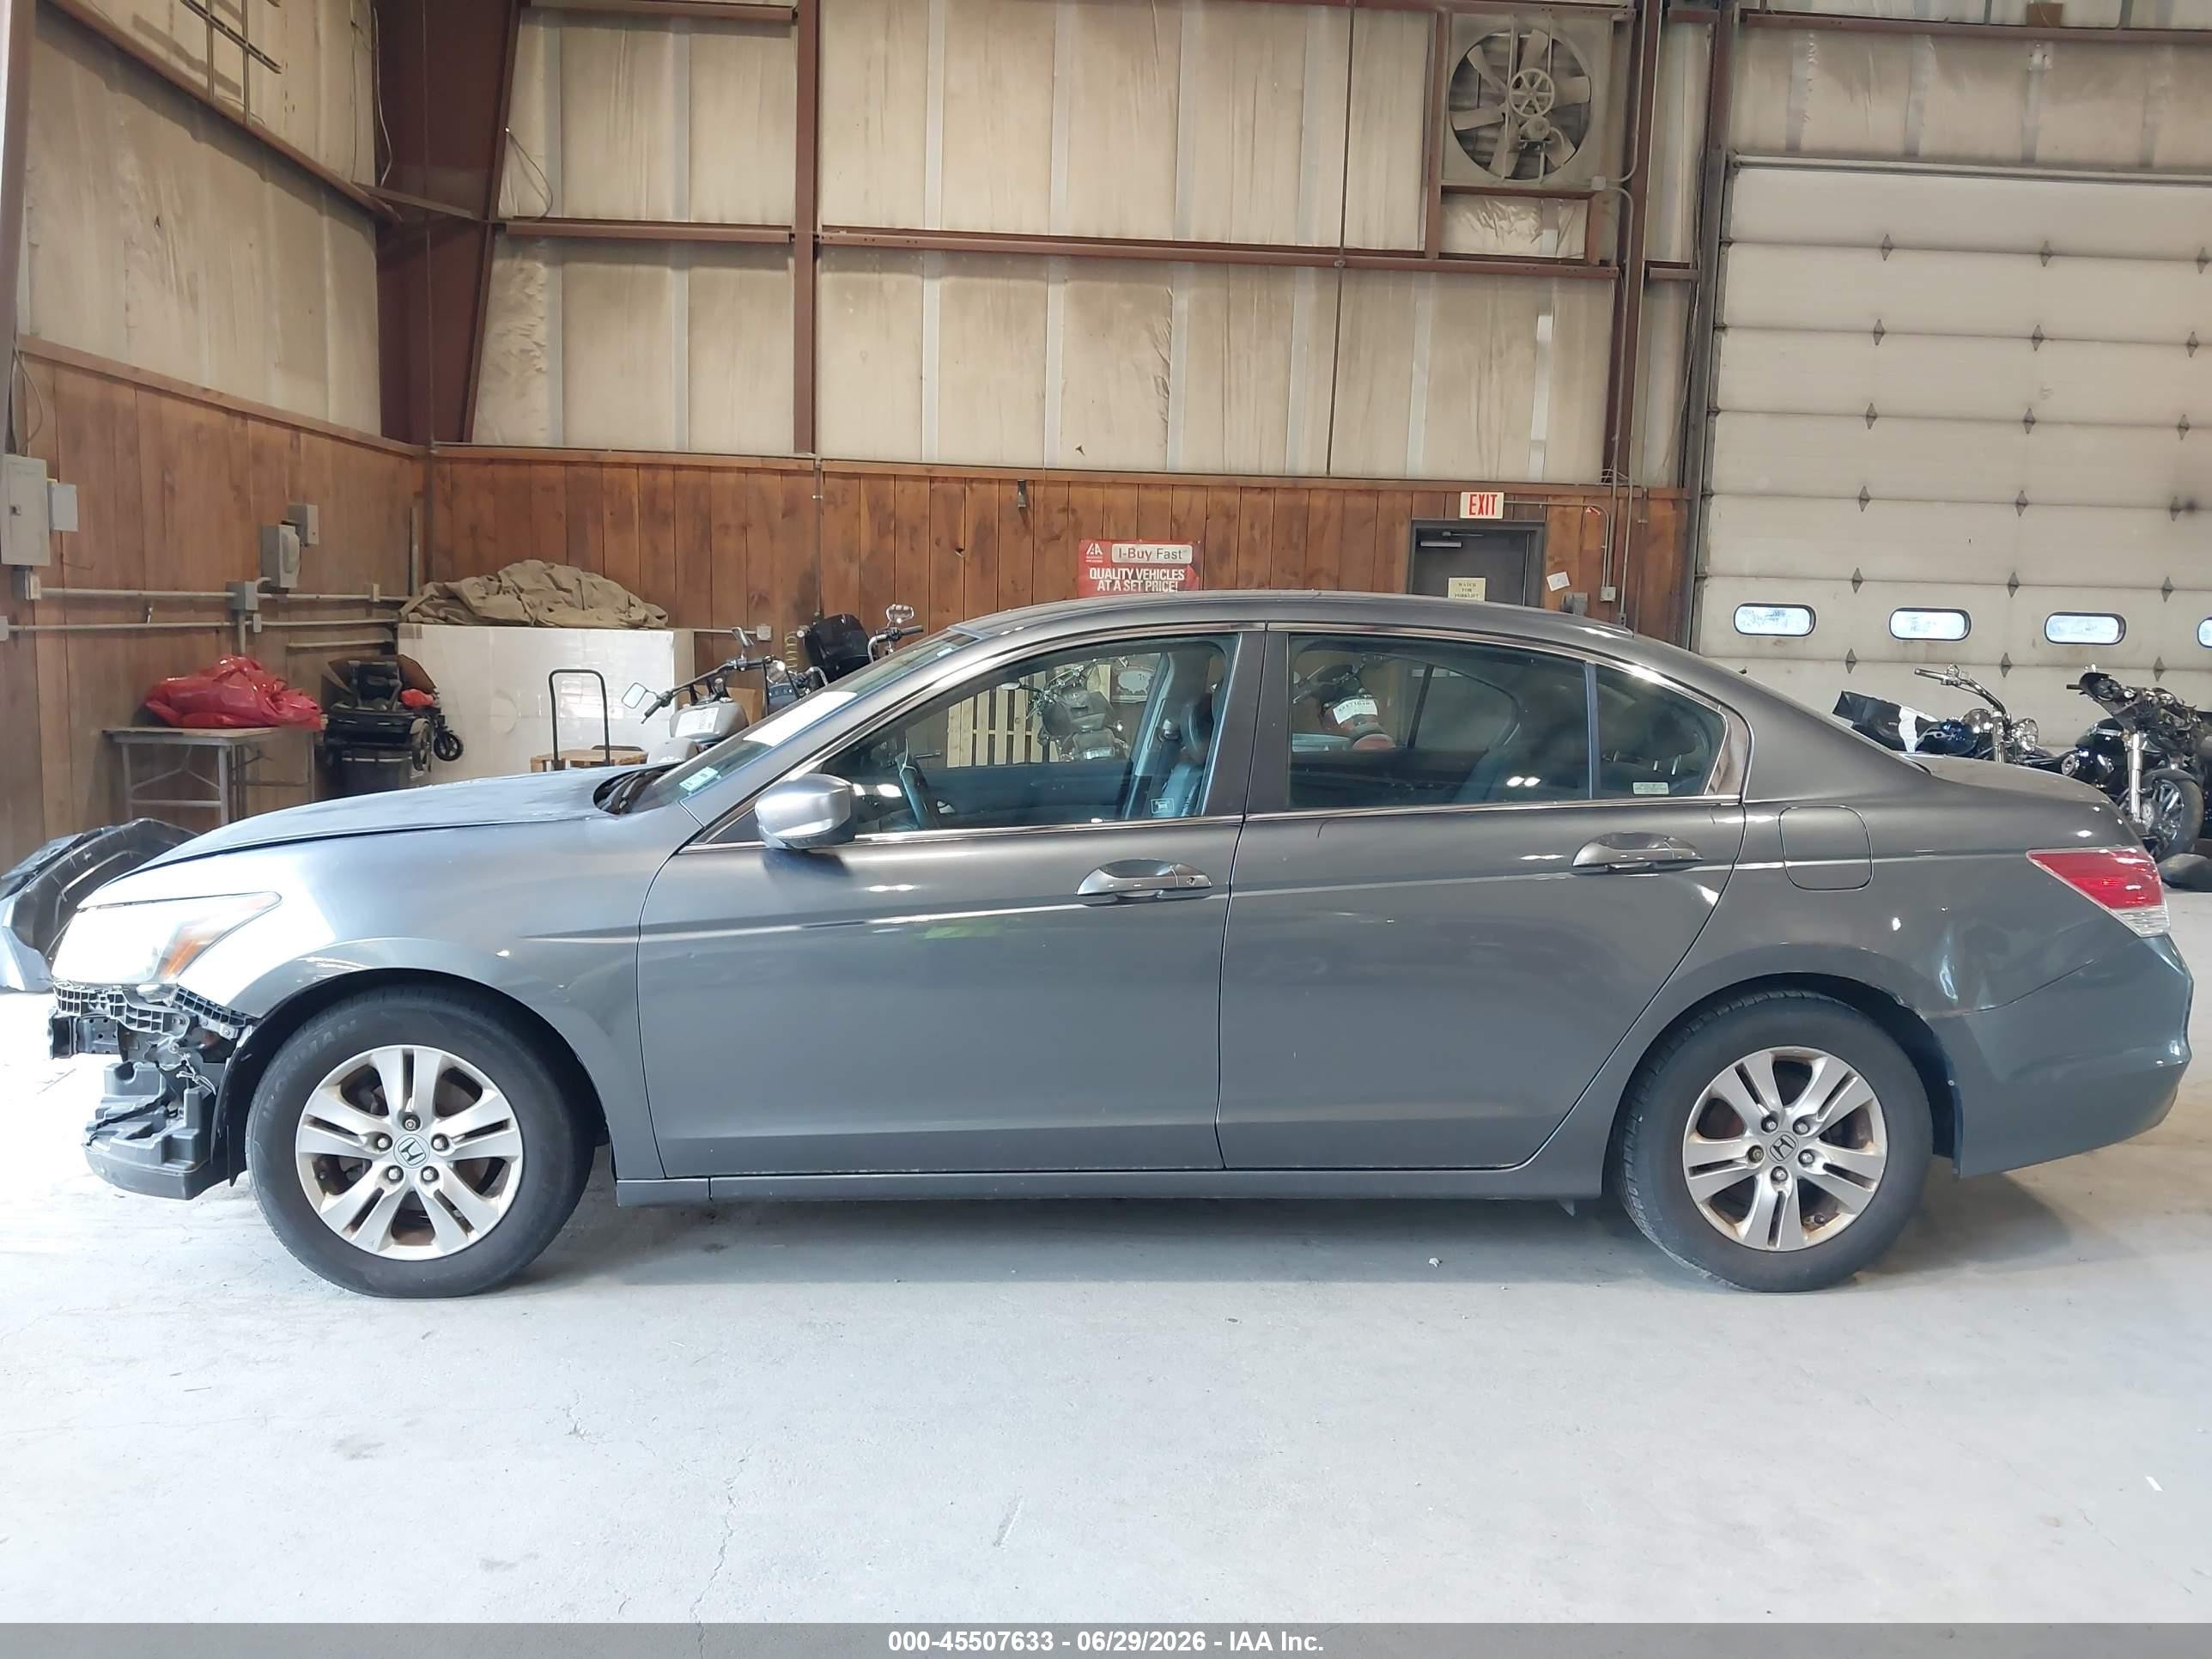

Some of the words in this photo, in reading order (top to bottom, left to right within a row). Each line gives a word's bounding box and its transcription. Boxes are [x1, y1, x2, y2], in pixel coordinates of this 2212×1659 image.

[1468, 494, 1498, 515] EXIT
[1118, 548, 1152, 561] I-Buy
[1089, 568, 1133, 580] QUALITY
[1136, 568, 1185, 580] VEHICLES
[1097, 580, 1113, 591] AT
[1113, 580, 1121, 591] A
[1123, 580, 1144, 592] SET
[1145, 580, 1178, 592] PRICE!
